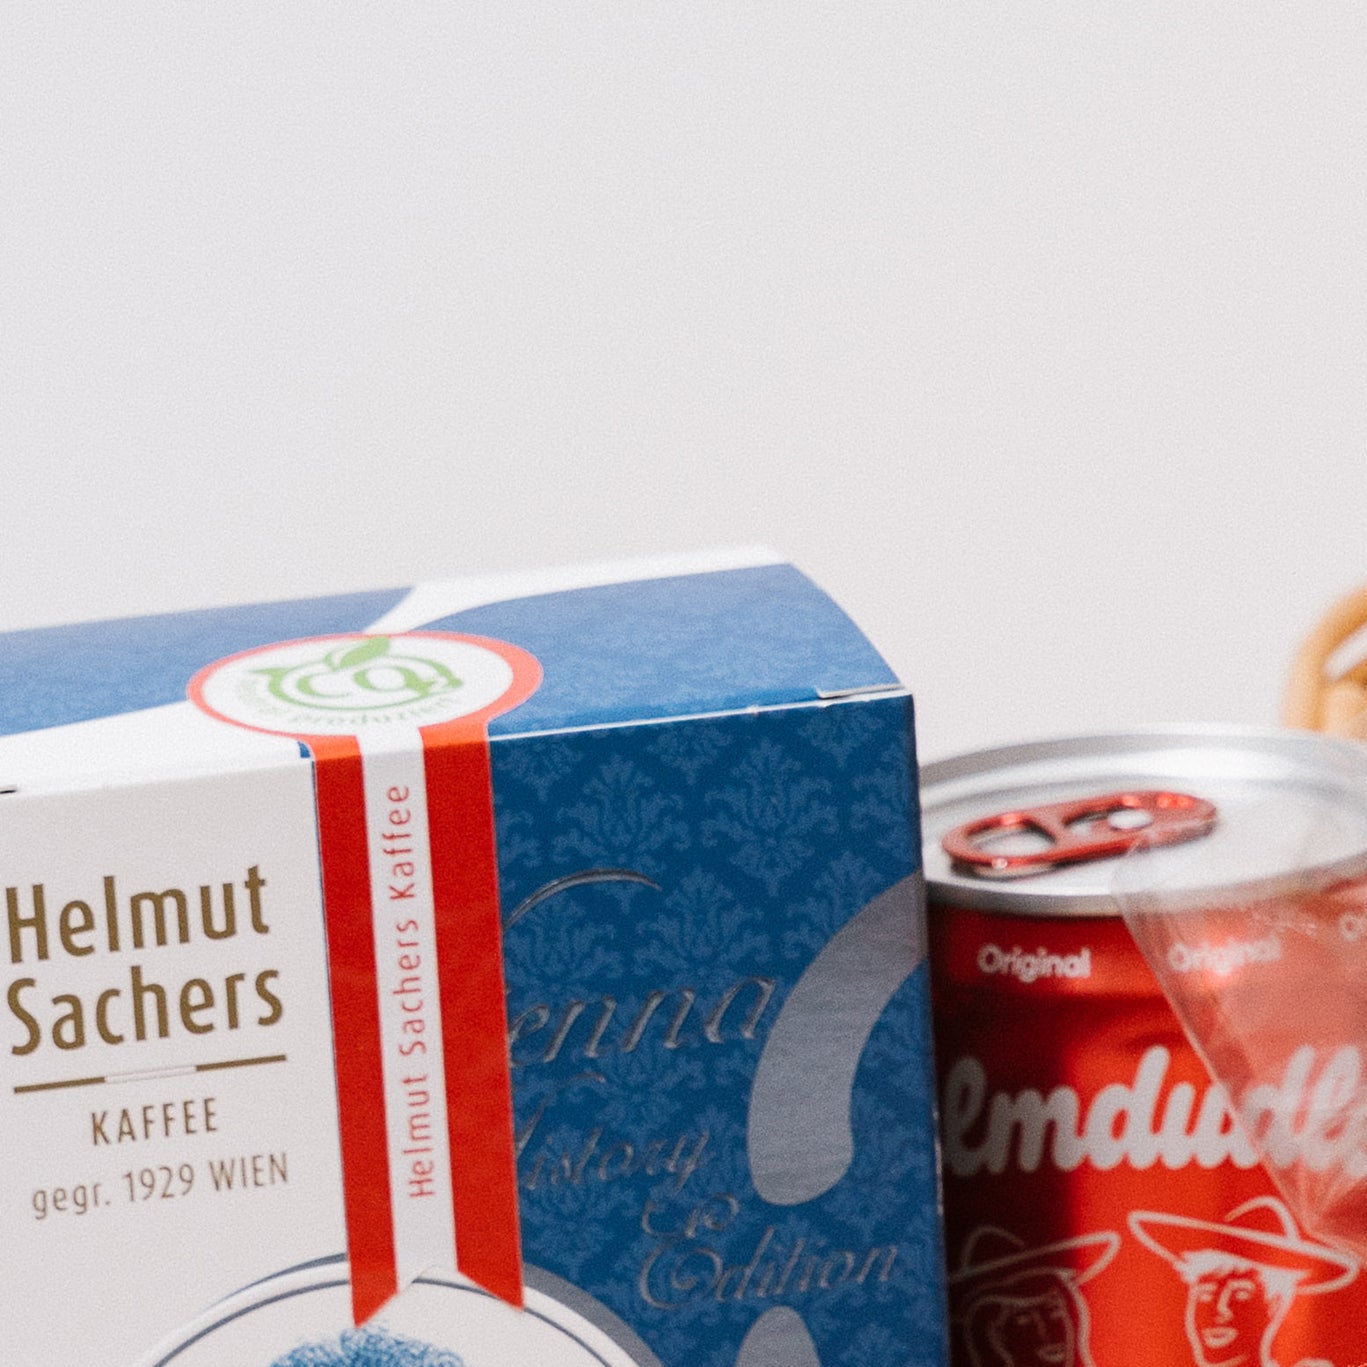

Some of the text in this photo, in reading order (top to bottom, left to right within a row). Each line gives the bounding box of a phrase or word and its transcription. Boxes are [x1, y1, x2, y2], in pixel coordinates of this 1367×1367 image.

[5, 865, 270, 964] Helmut
[382, 785, 435, 1199] Helmut Sachers Kaffee
[977, 943, 1092, 983] Original
[6, 965, 284, 1056] Sachers
[90, 1098, 218, 1146] KAFFEE
[32, 1152, 289, 1220] gegr. 1929 WIEN
